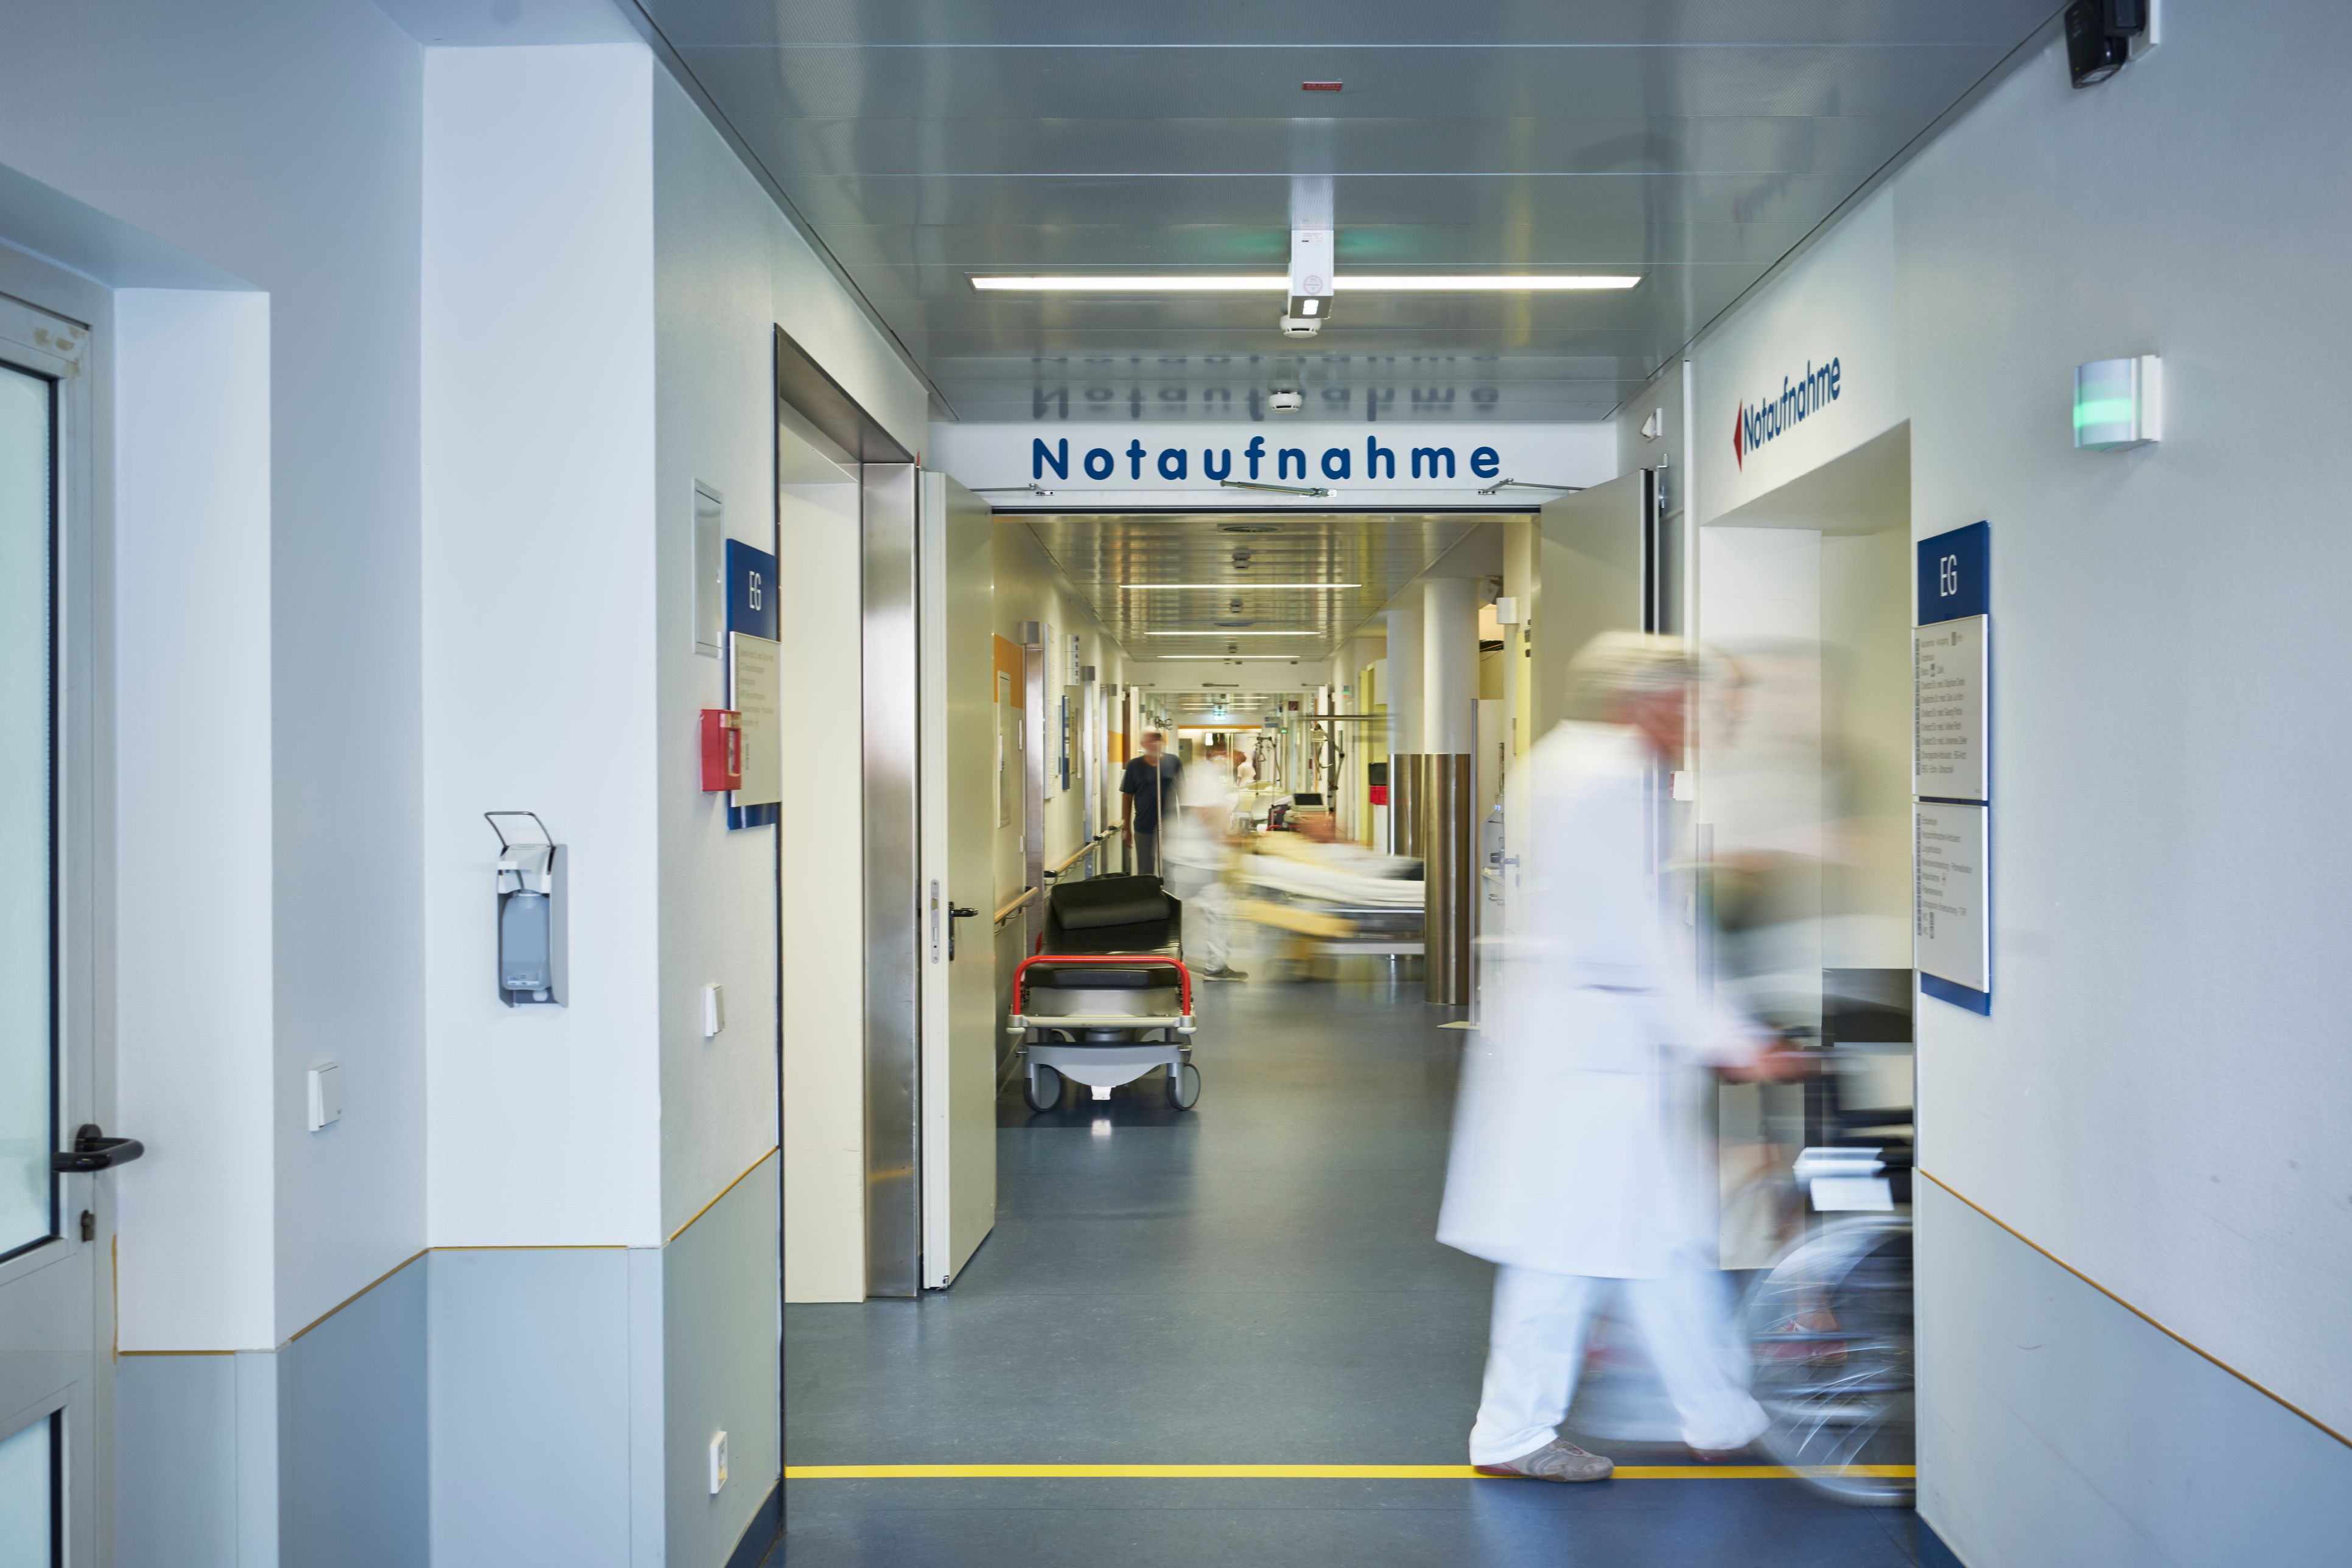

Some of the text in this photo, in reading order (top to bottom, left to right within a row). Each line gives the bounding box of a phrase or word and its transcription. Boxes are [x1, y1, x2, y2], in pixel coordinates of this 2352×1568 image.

[1744, 357, 1840, 455] Notaufnahme
[1032, 435, 1501, 481] Notaufnahme
[749, 570, 761, 611] EG
[1940, 555, 1958, 597] EG
